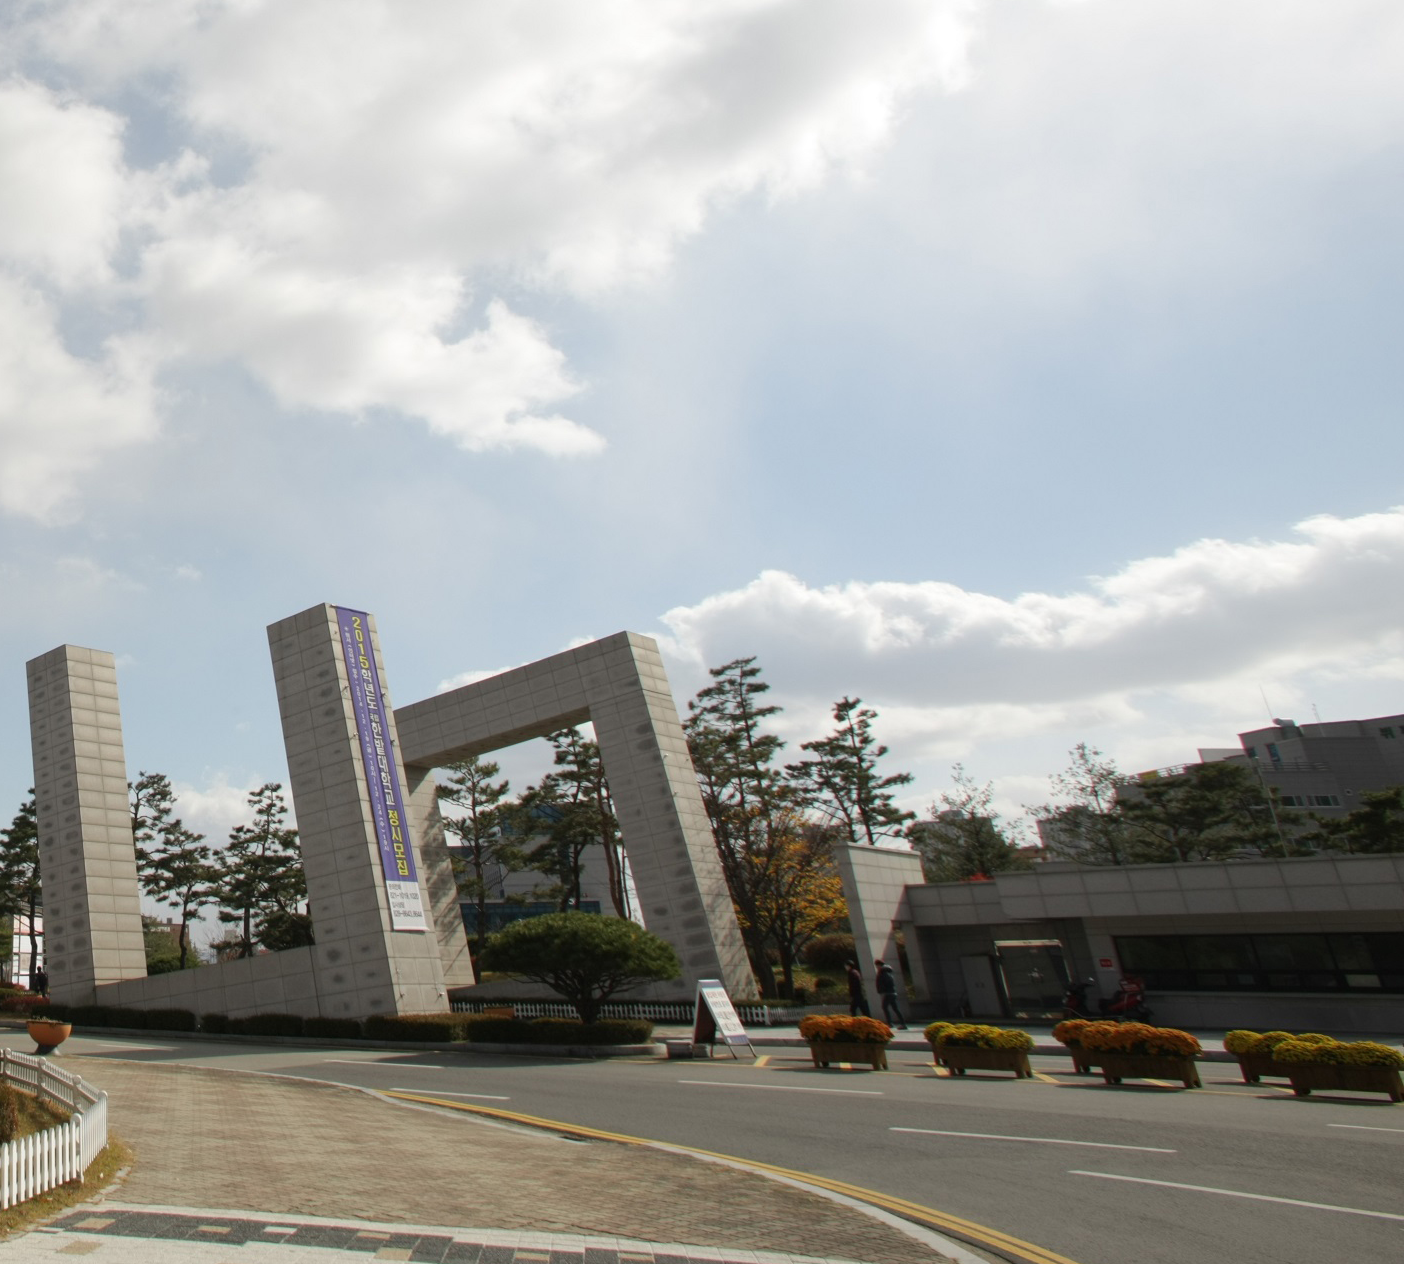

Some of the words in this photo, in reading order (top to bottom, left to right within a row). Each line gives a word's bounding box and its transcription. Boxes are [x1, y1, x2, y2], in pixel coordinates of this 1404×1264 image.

[352, 616, 377, 710] 2015학년도
[371, 722, 395, 806] 한밭대학교
[388, 810, 409, 876] 정시모집
